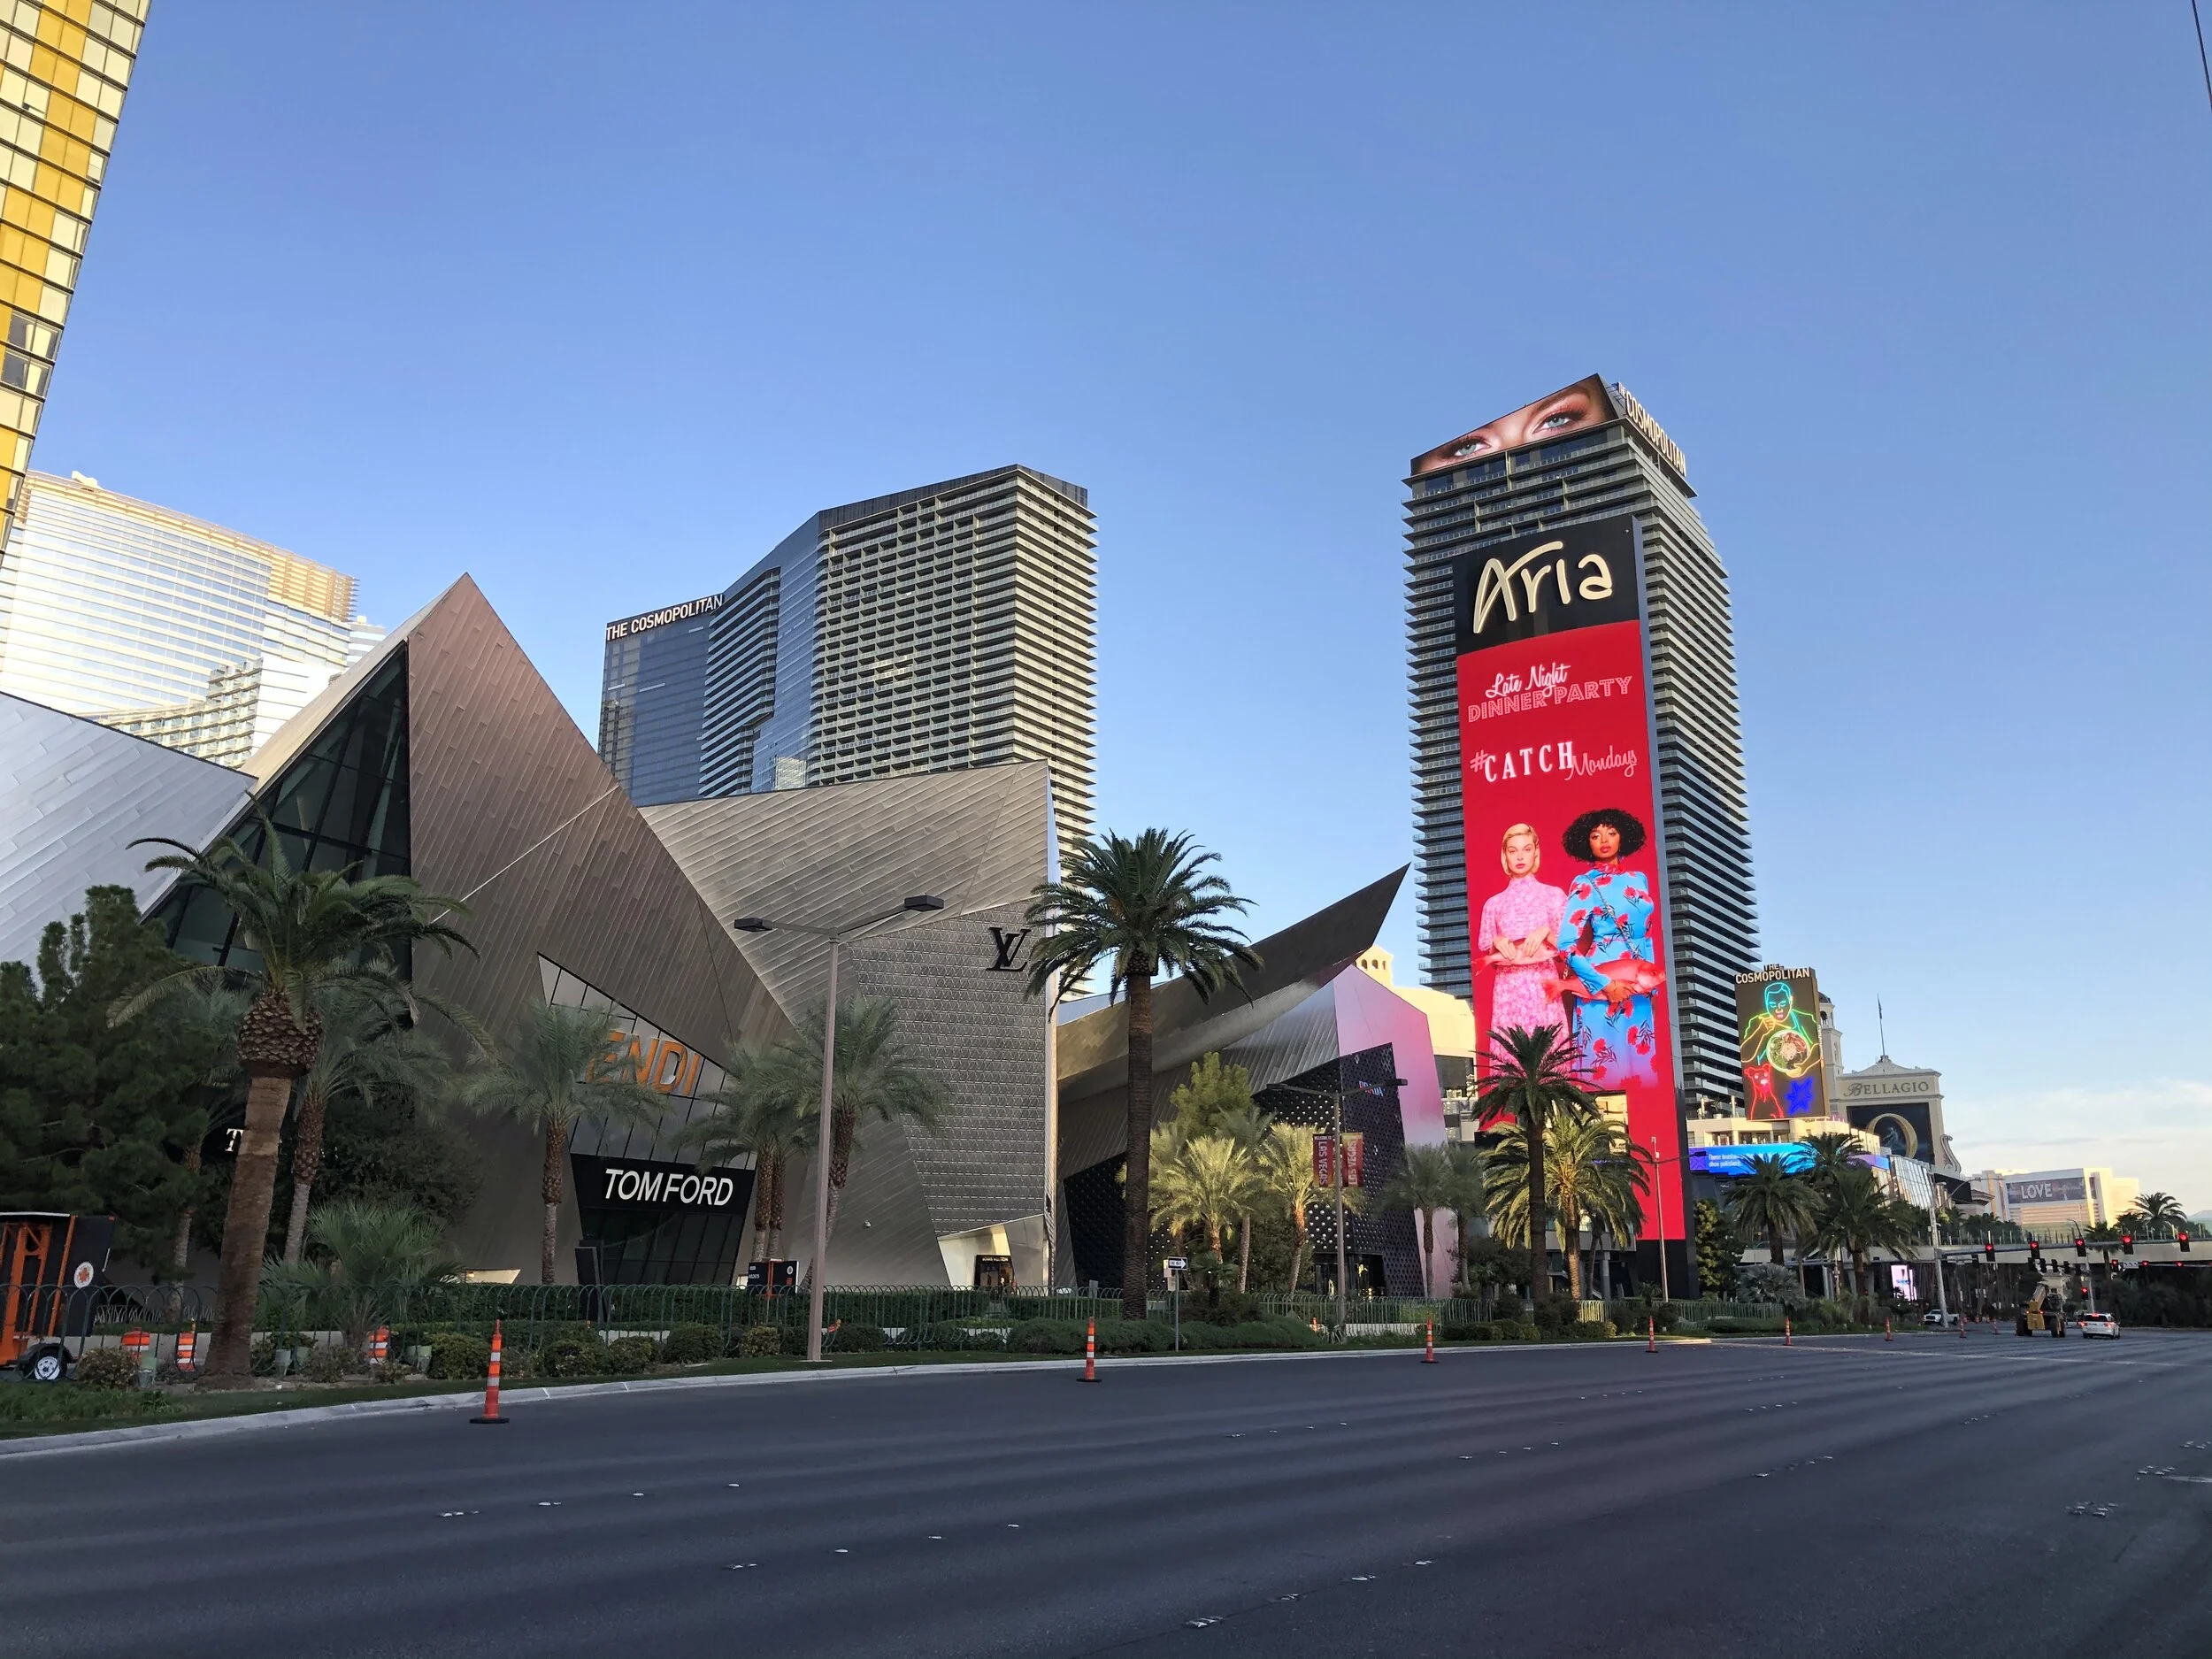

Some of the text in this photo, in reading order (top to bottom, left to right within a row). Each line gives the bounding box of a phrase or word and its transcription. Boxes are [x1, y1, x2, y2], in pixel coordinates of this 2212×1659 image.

[1626, 391, 1686, 477] COSMOPOLITAN
[1473, 541, 1613, 634] Aria
[606, 594, 723, 641] THE COSMOPOLITAN
[1486, 662, 1571, 698] Late Night
[1468, 675, 1633, 723] DINNER PARTY
[1735, 968, 1810, 984] COSMOPOLITAN
[1843, 1081, 1929, 1097] BELLAGIO
[1318, 1141, 1328, 1185] LAS VEGAS
[1347, 1140, 1357, 1167] VEGAS
[605, 1168, 733, 1206] TOM FORD
[1348, 1168, 1358, 1186] LAS
[2020, 1183, 2053, 1199] LOVE
